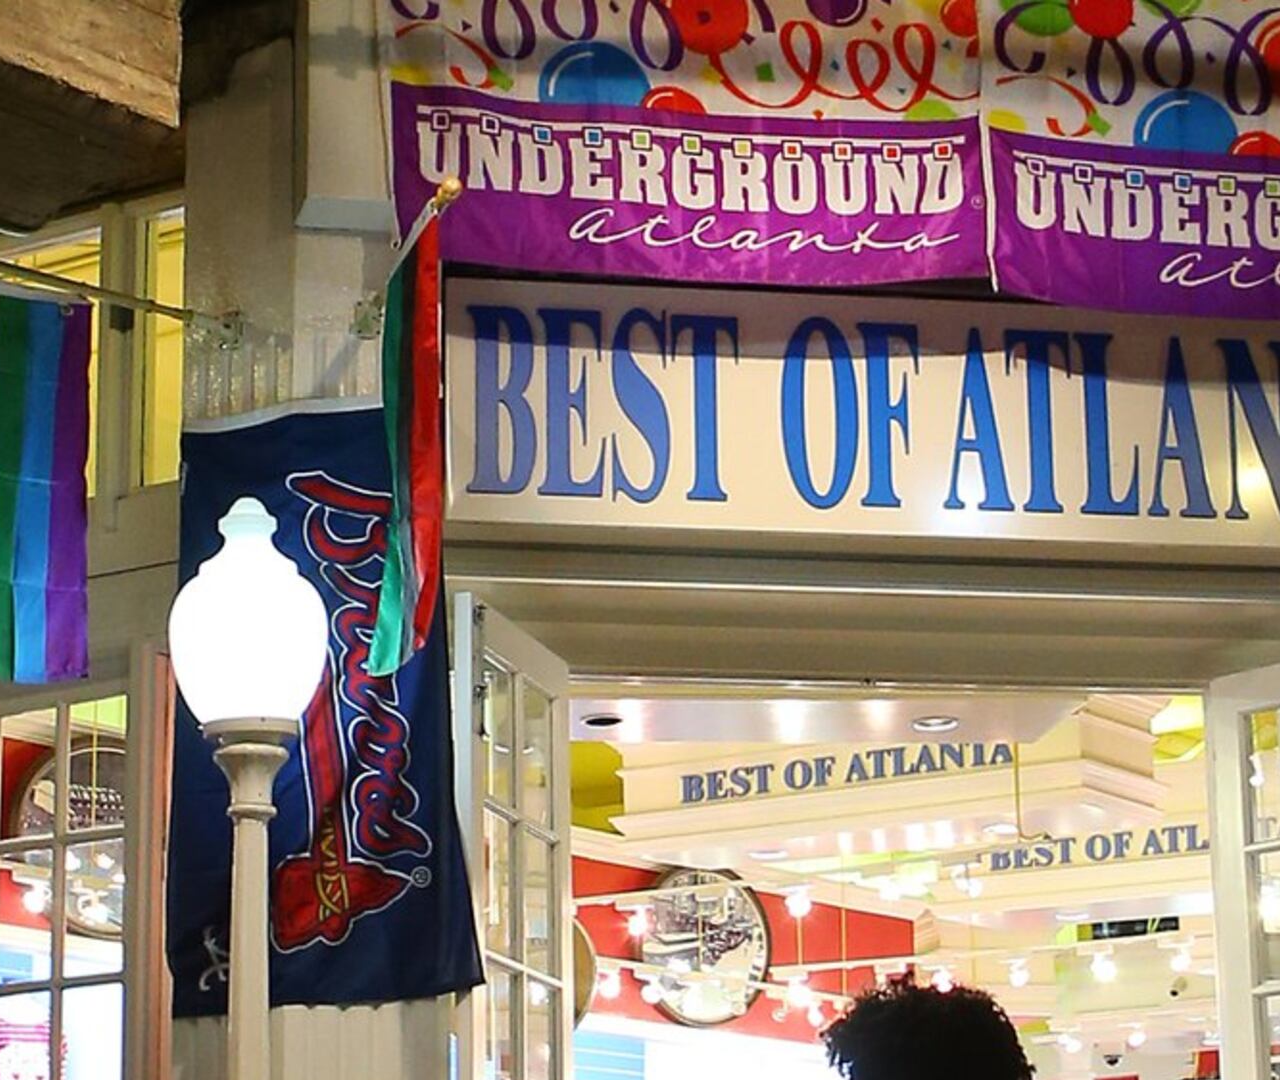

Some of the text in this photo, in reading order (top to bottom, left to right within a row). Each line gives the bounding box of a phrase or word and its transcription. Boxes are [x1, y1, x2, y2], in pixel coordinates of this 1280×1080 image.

[417, 112, 964, 215] UNDERGROUND
[465, 303, 740, 506] BEST
[779, 319, 921, 513] OF
[680, 742, 1015, 805] BEST OF ATLANTA
[989, 837, 1076, 872] BEST
[1084, 831, 1133, 862] OF
